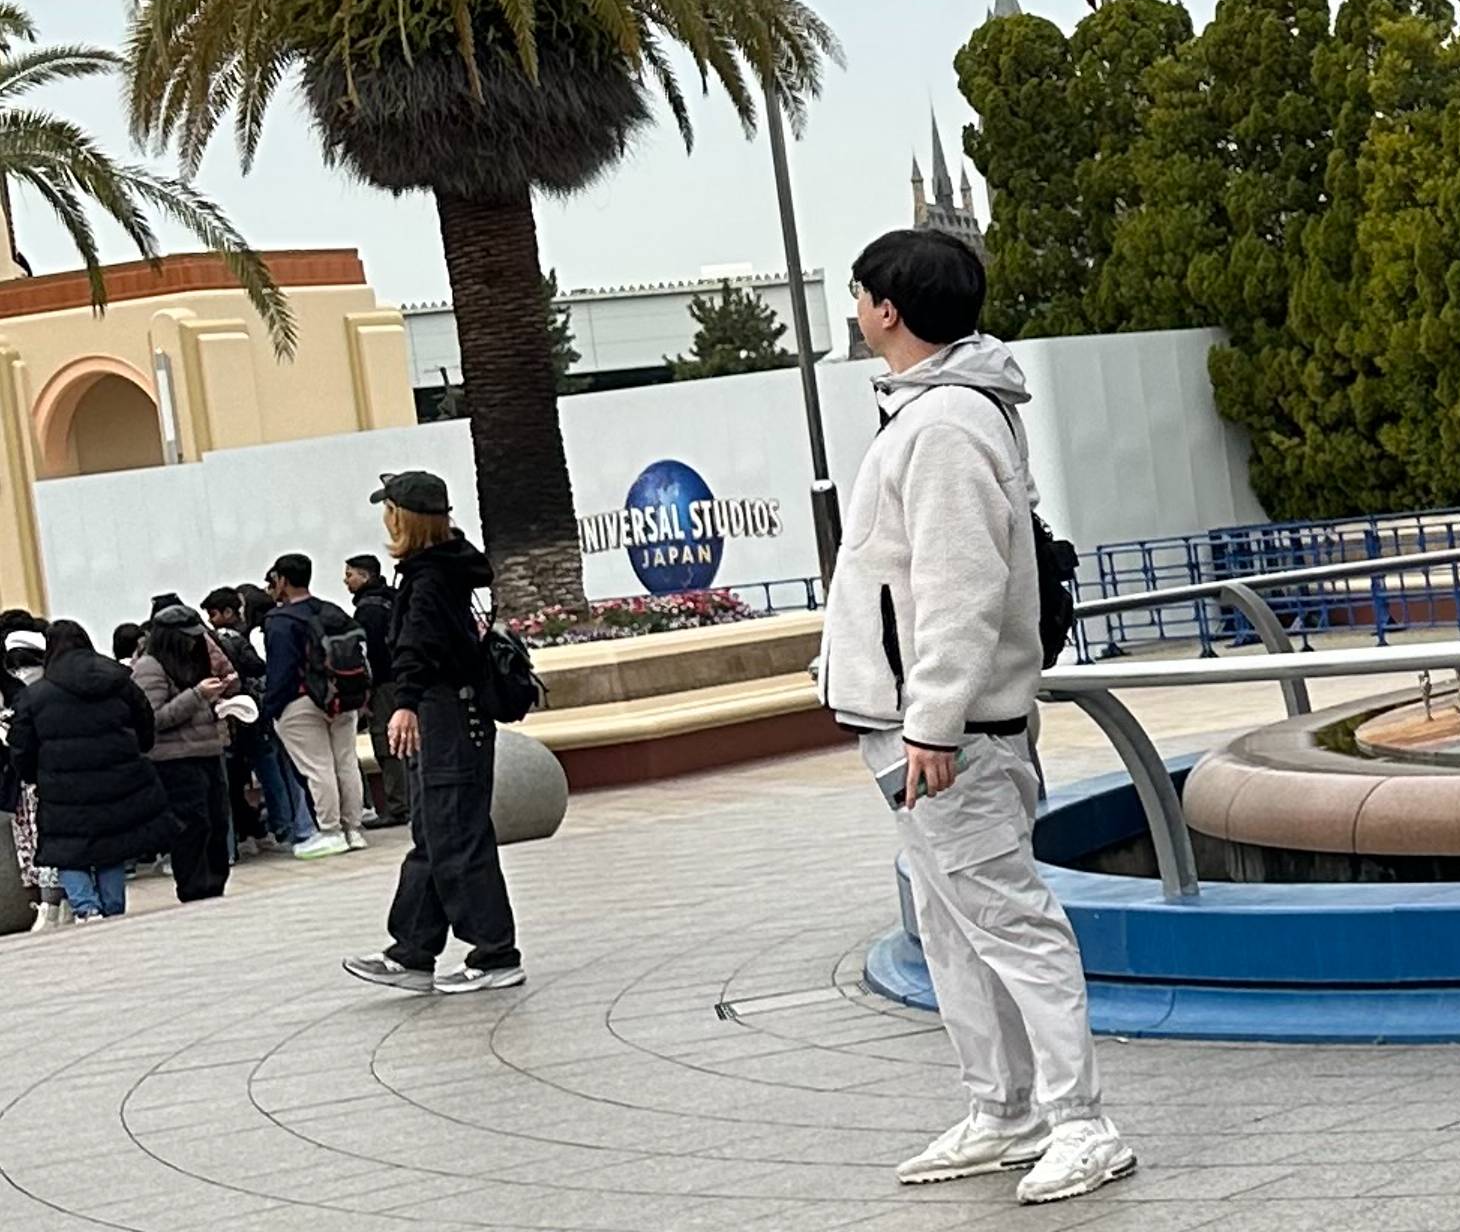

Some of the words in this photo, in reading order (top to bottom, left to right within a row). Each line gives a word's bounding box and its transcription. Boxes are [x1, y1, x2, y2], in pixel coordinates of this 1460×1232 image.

[579, 503, 685, 554] NIVERSAL
[689, 499, 783, 537] STUDIOS
[642, 543, 712, 568] JAPAN
